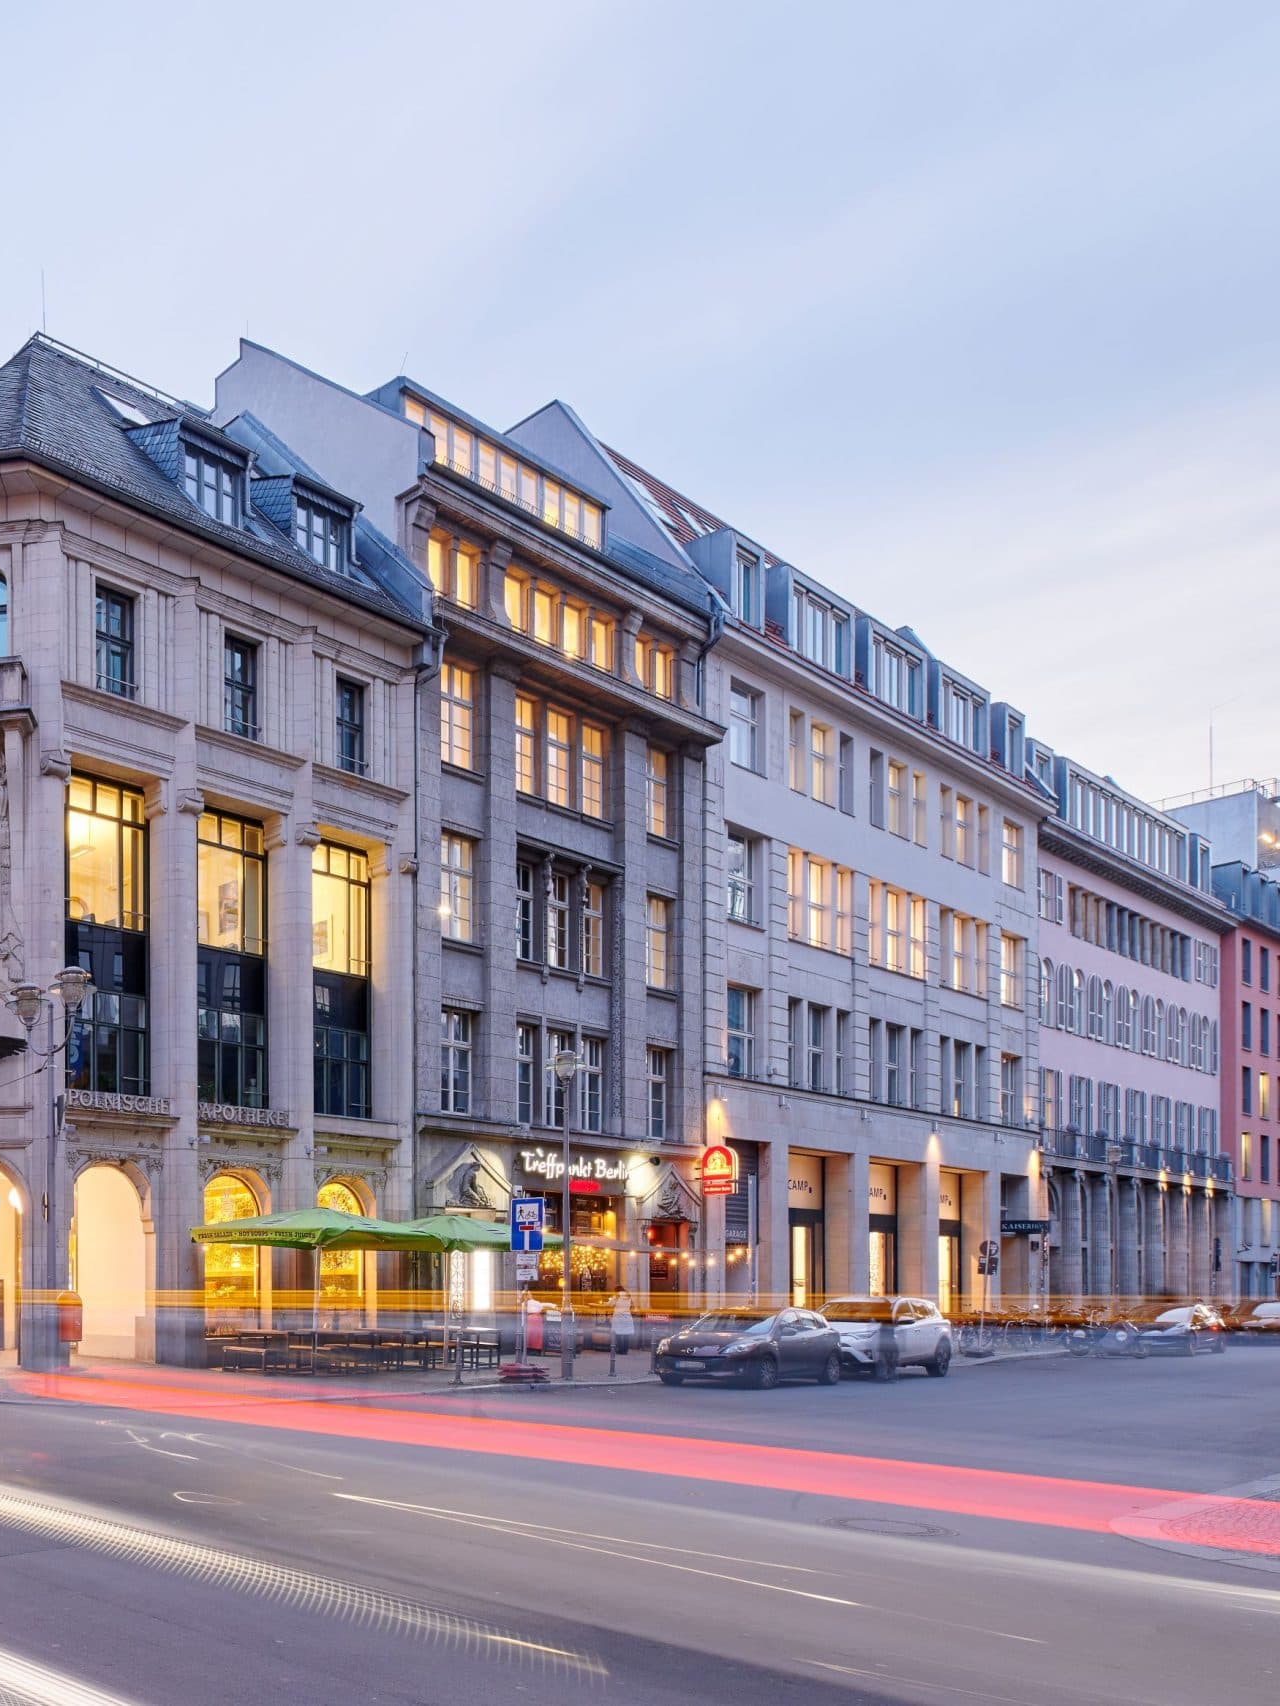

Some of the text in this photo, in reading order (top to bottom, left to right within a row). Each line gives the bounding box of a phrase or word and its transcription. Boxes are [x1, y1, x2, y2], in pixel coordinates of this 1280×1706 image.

[69, 1089, 288, 1126] POLNISCHE APOTHEKE
[594, 1158, 632, 1179] Berlin
[725, 1229, 747, 1239] GARAGE
